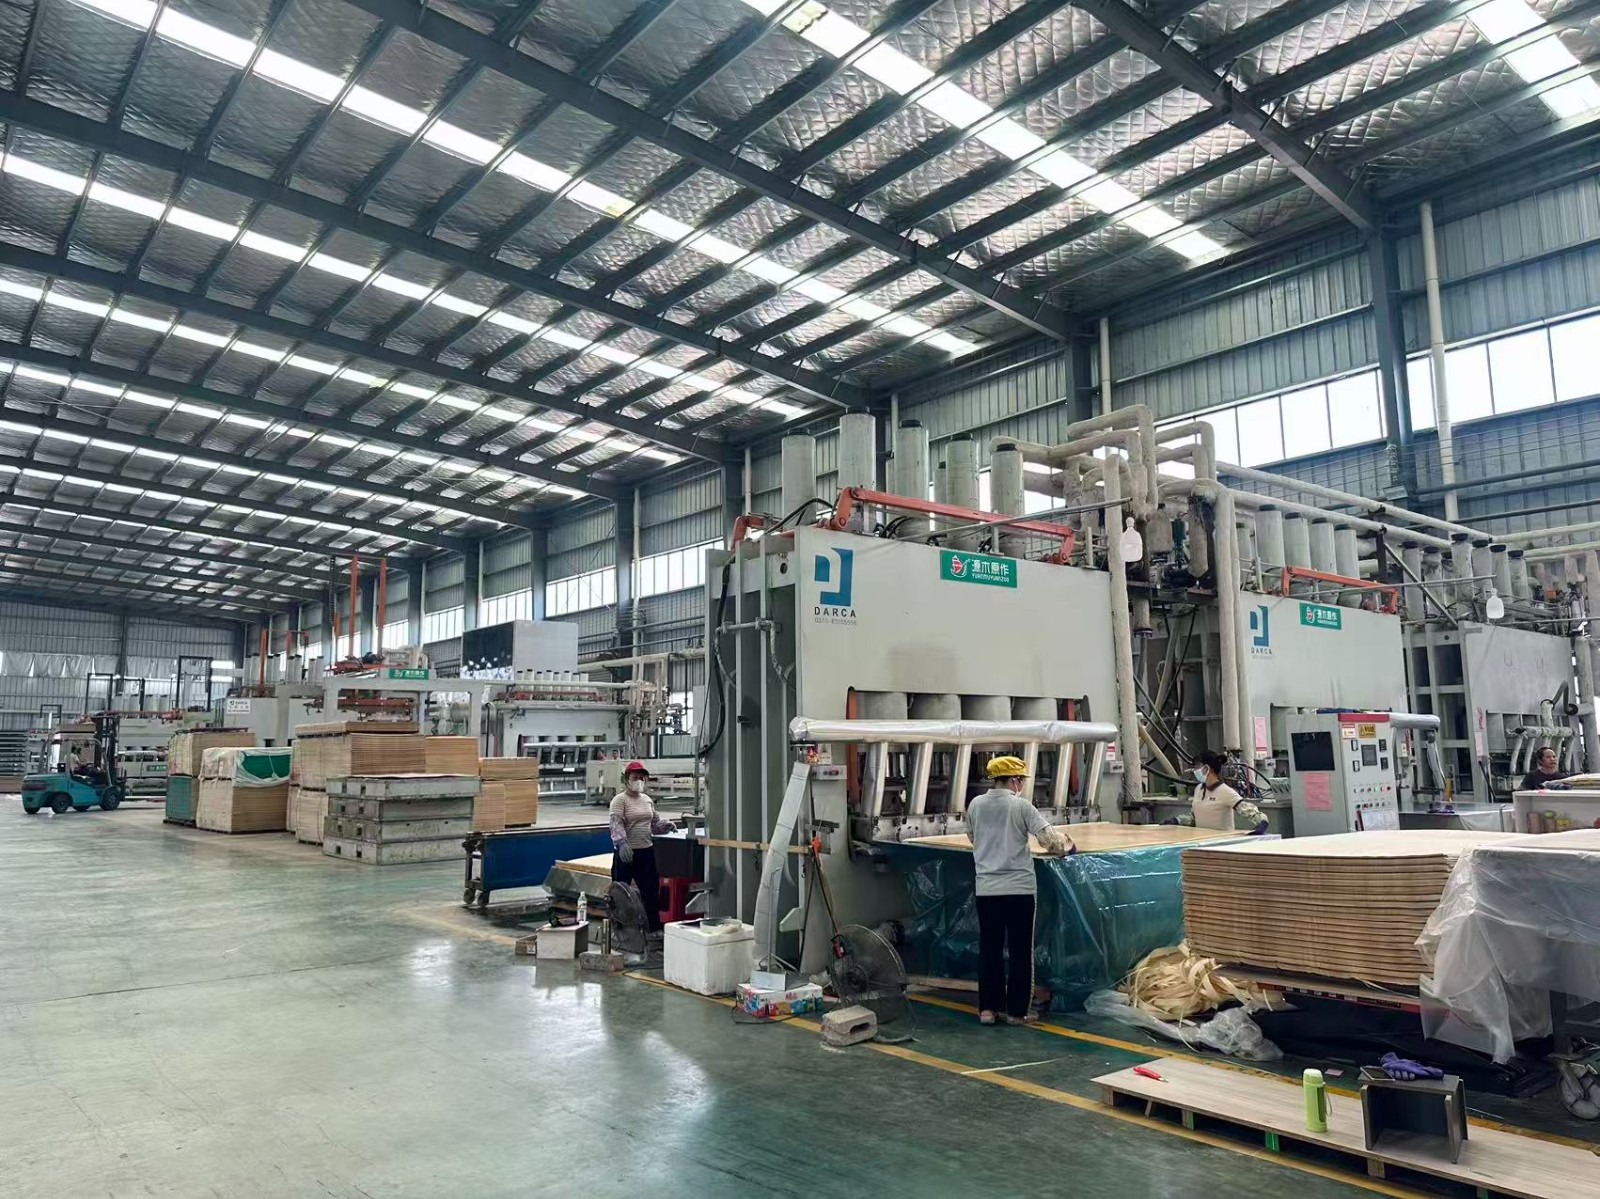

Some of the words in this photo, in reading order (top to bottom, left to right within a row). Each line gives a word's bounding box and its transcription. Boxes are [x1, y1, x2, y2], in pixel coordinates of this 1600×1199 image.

[971, 559, 1010, 576] 源木原作
[814, 606, 857, 618] DARCA
